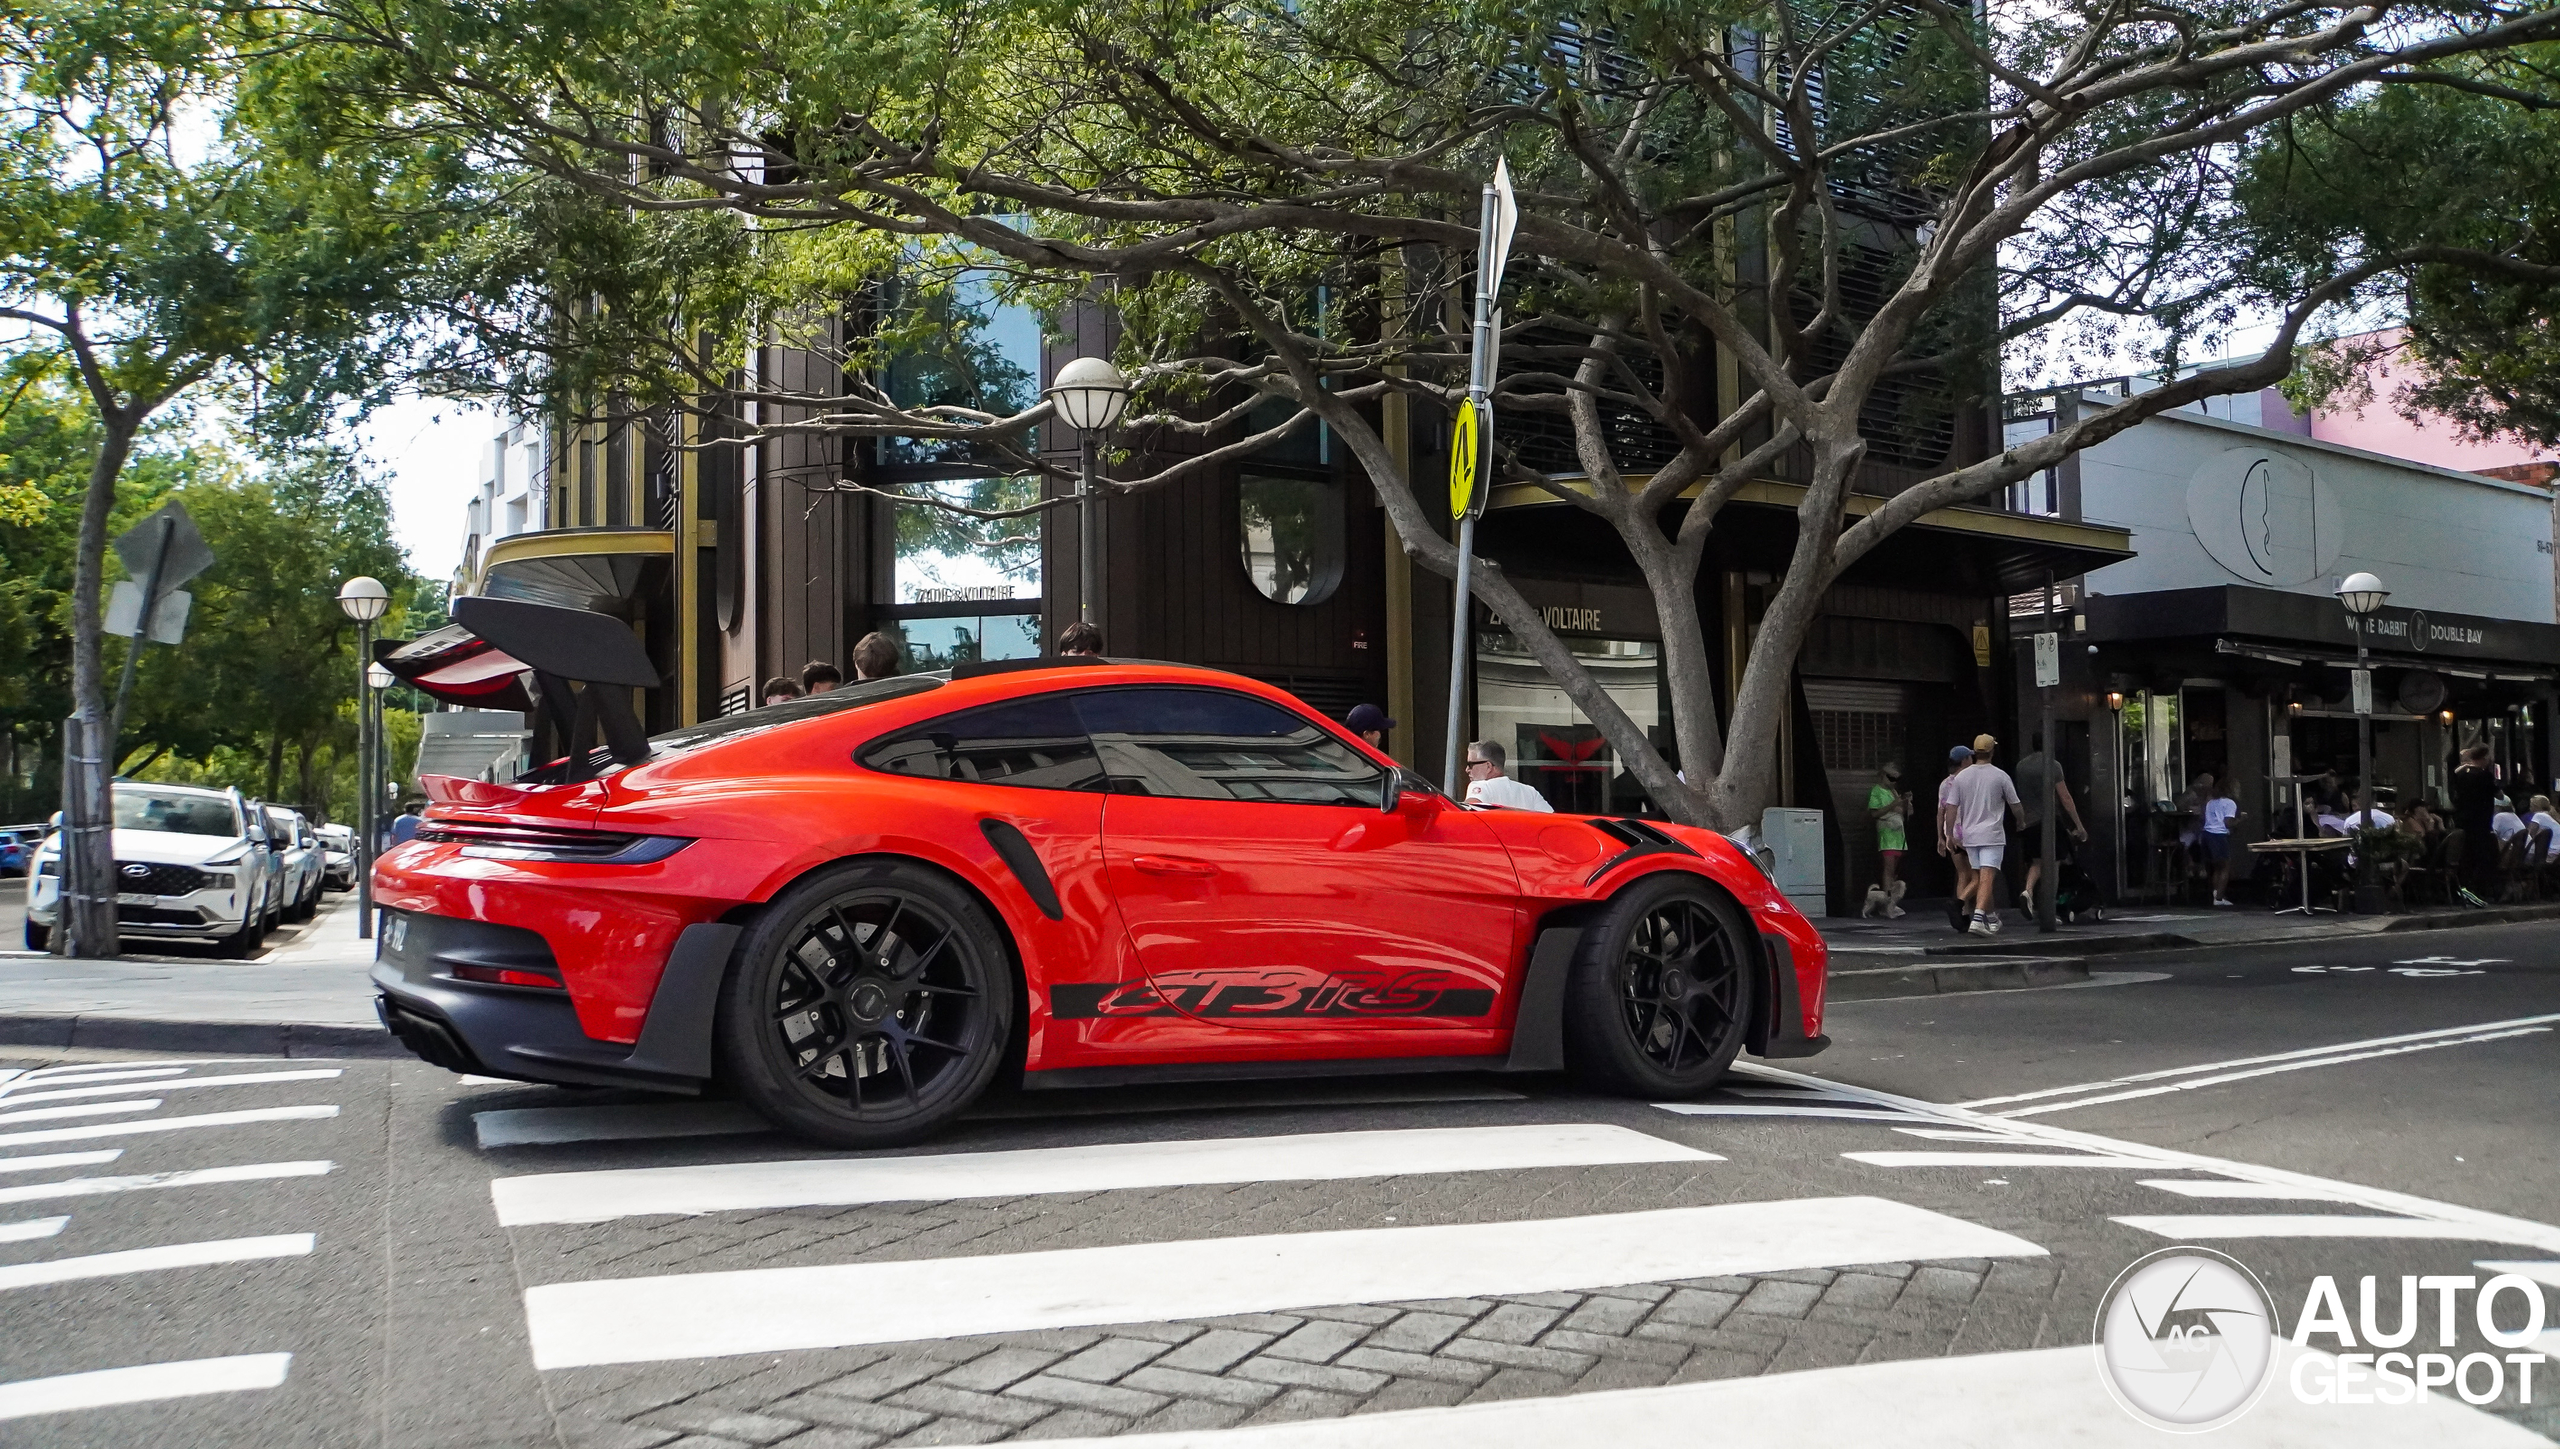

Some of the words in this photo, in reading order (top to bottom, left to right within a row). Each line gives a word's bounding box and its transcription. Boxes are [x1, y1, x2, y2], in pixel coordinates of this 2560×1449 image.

[2378, 619, 2408, 637] RABBIT
[2430, 625, 2465, 642] DOUBLE
[2467, 628, 2483, 644] BAY
